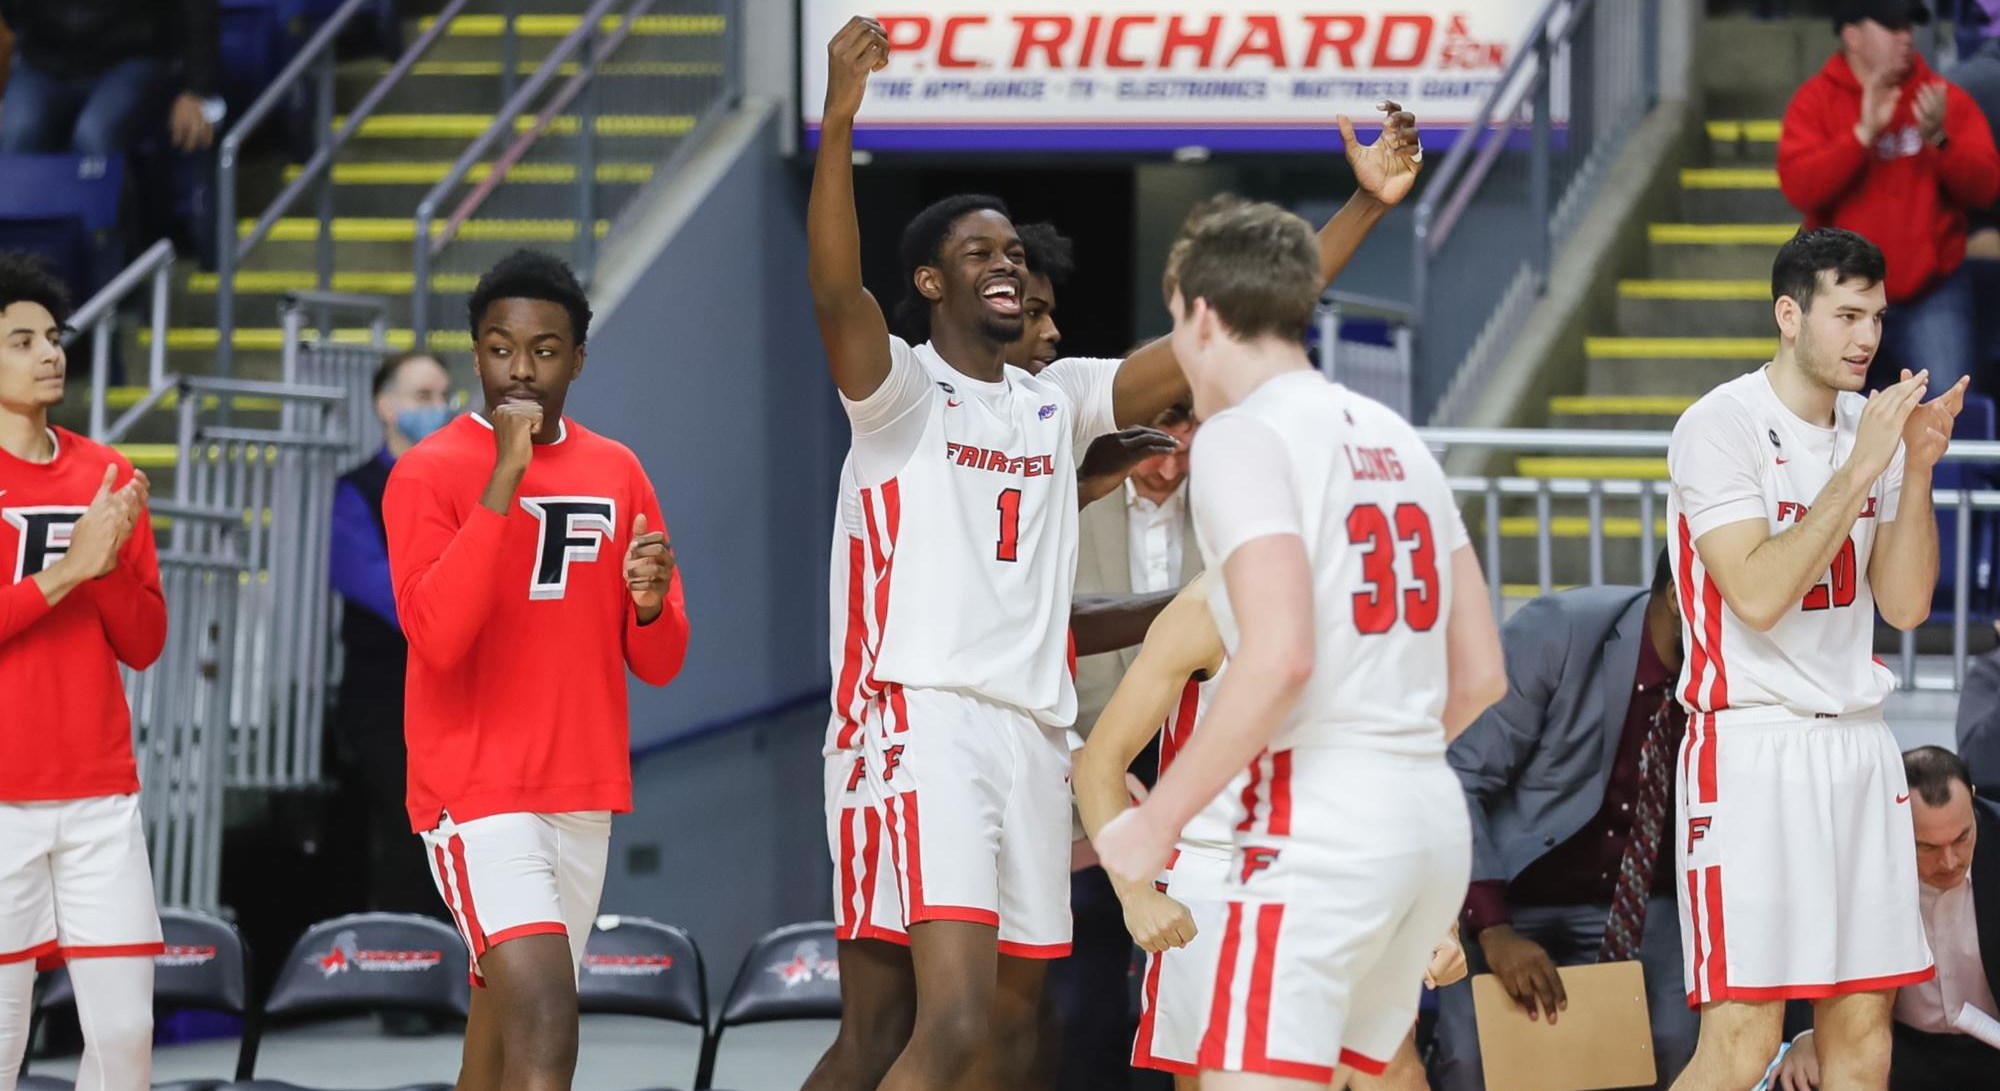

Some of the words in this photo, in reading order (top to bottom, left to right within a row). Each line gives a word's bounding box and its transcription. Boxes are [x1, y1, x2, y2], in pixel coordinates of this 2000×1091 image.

[1011, 15, 1433, 69] RICHARD
[1117, 80, 1267, 98] ELECTRONICS
[1343, 443, 1406, 482] LONG
[996, 487, 1022, 562] 1
[520, 495, 617, 601] F
[1345, 502, 1440, 635] 33
[882, 744, 905, 783] F
[1687, 815, 1713, 854] F
[1240, 846, 1281, 886] F
